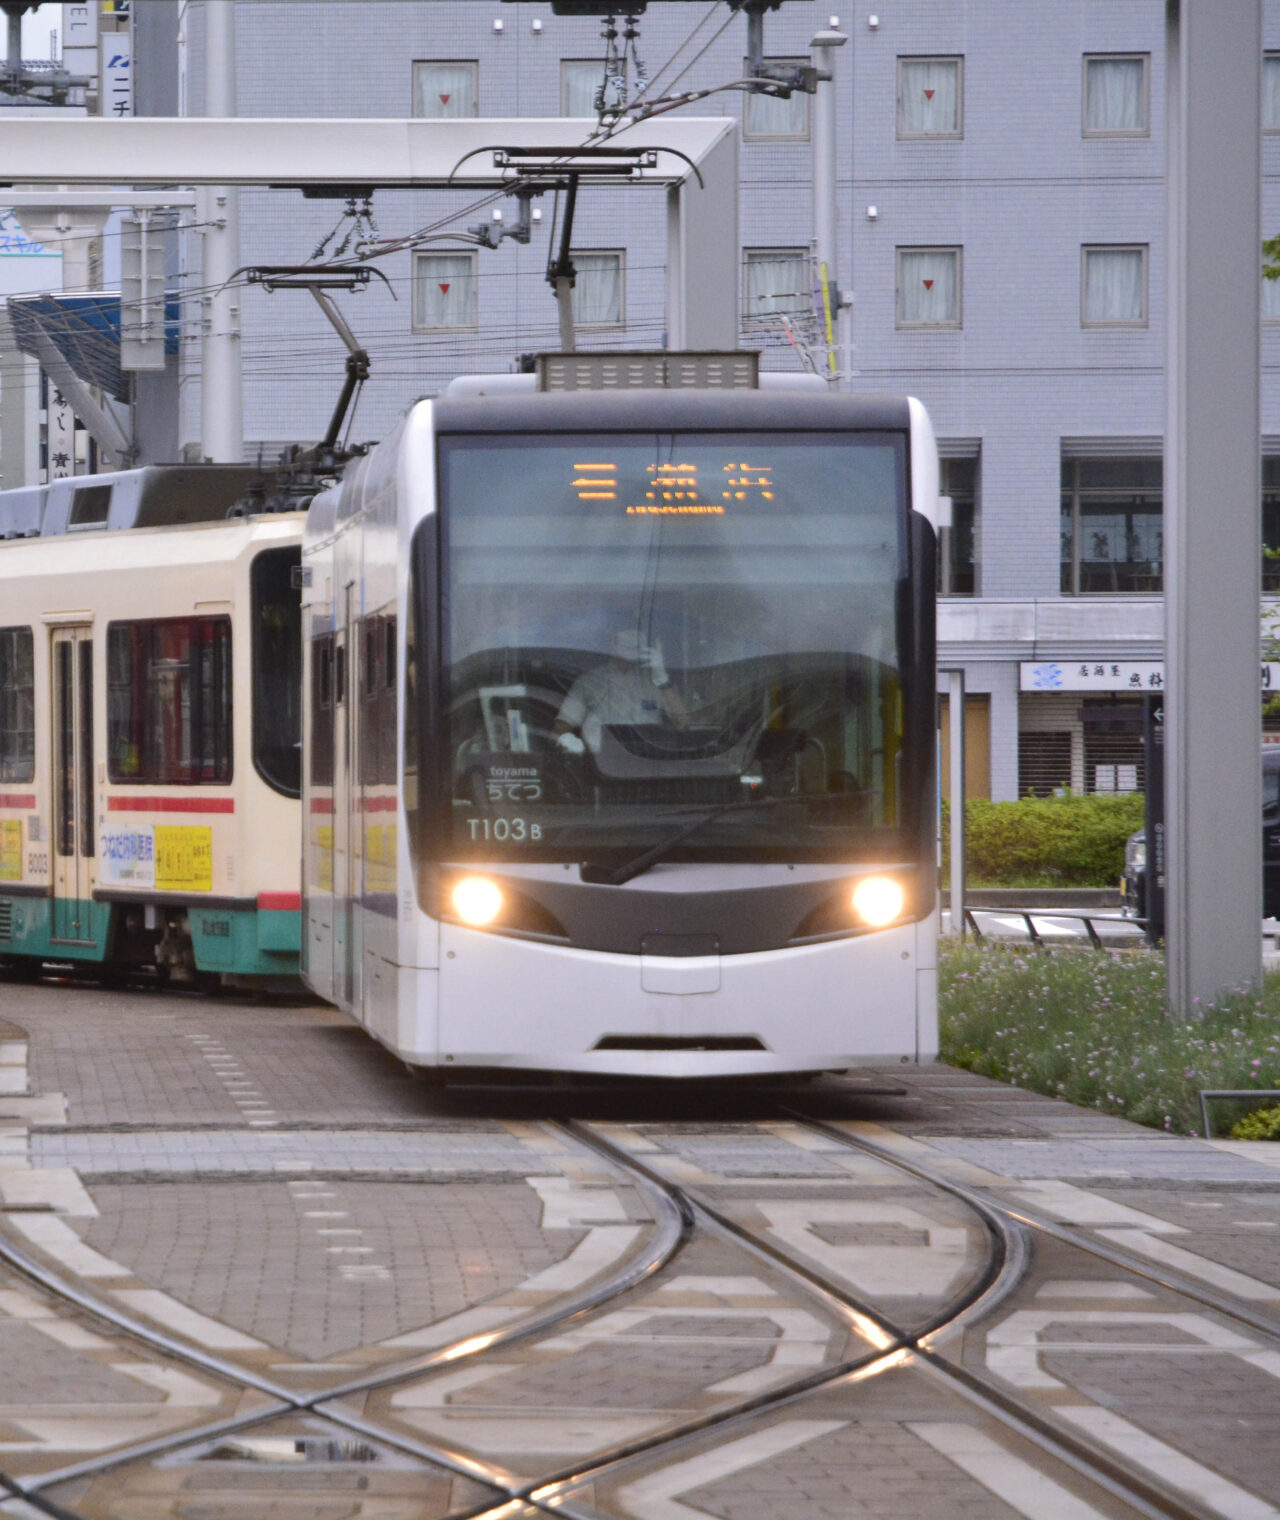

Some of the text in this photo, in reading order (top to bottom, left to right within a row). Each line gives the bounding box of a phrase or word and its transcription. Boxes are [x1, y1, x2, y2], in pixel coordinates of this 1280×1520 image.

[489, 766, 538, 778] toyama
[485, 783, 542, 801] ちてつ
